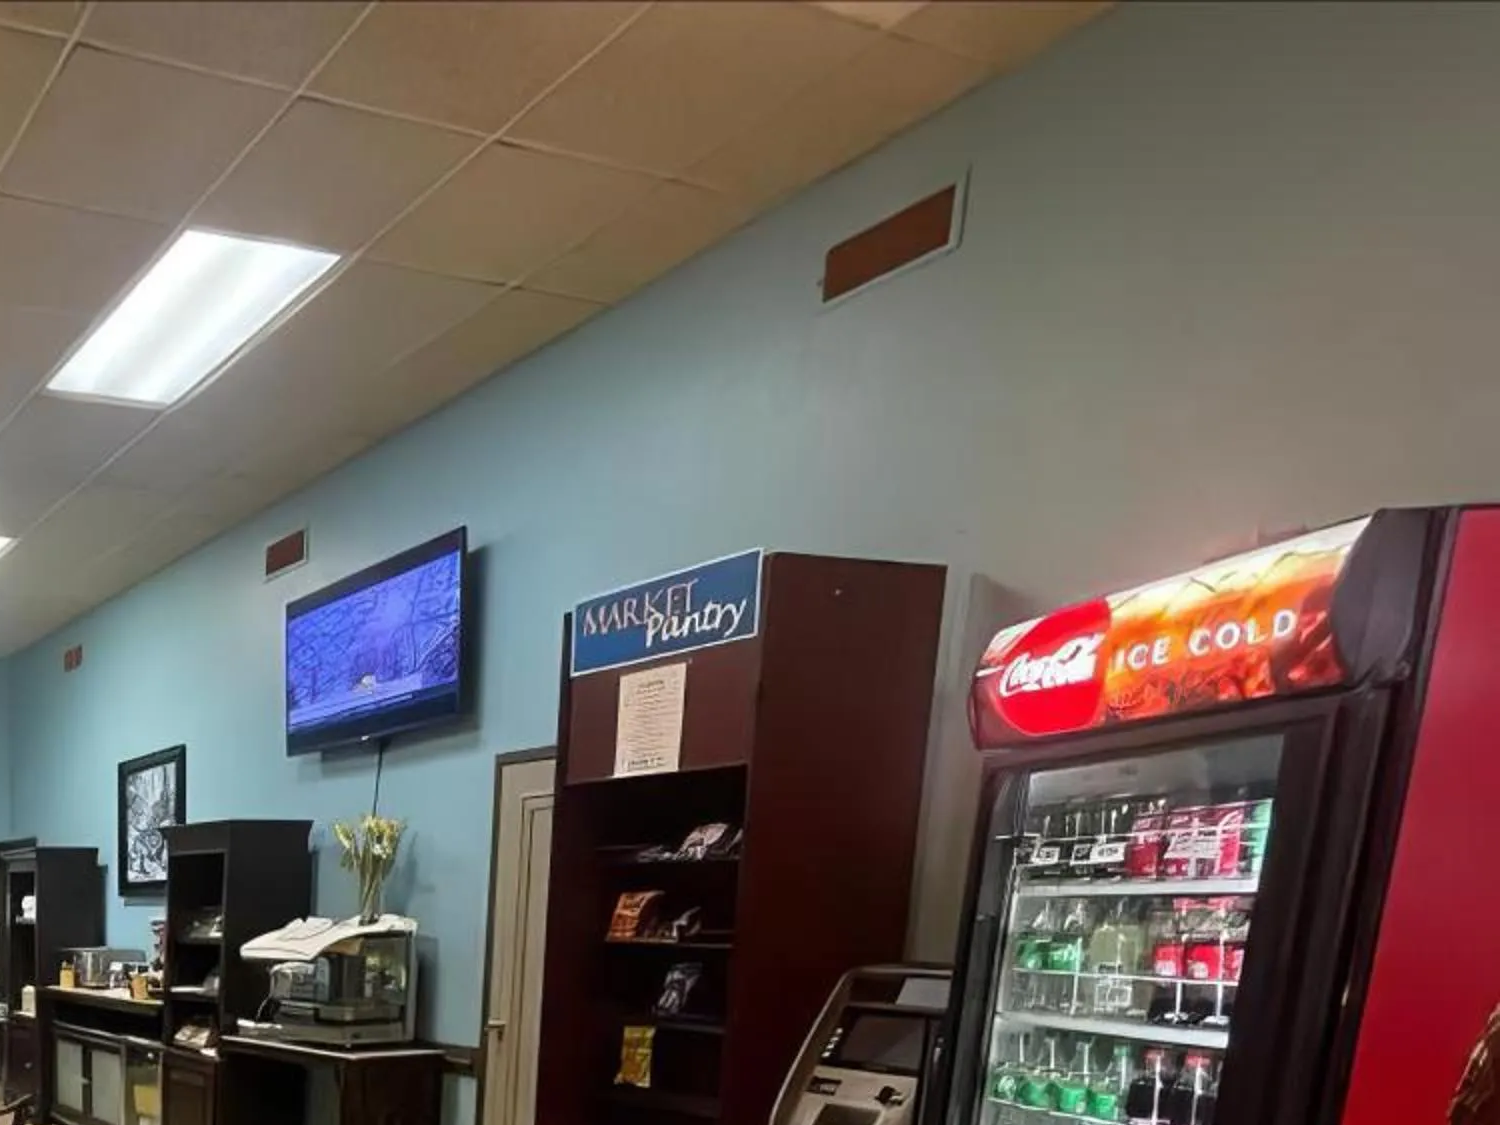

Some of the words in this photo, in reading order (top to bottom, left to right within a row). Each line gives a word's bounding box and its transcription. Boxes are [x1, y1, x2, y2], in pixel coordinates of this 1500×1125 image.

[583, 577, 699, 637] MARKET
[645, 597, 747, 648] Pantry
[1113, 634, 1171, 671] ICE
[1188, 608, 1298, 657] COLD
